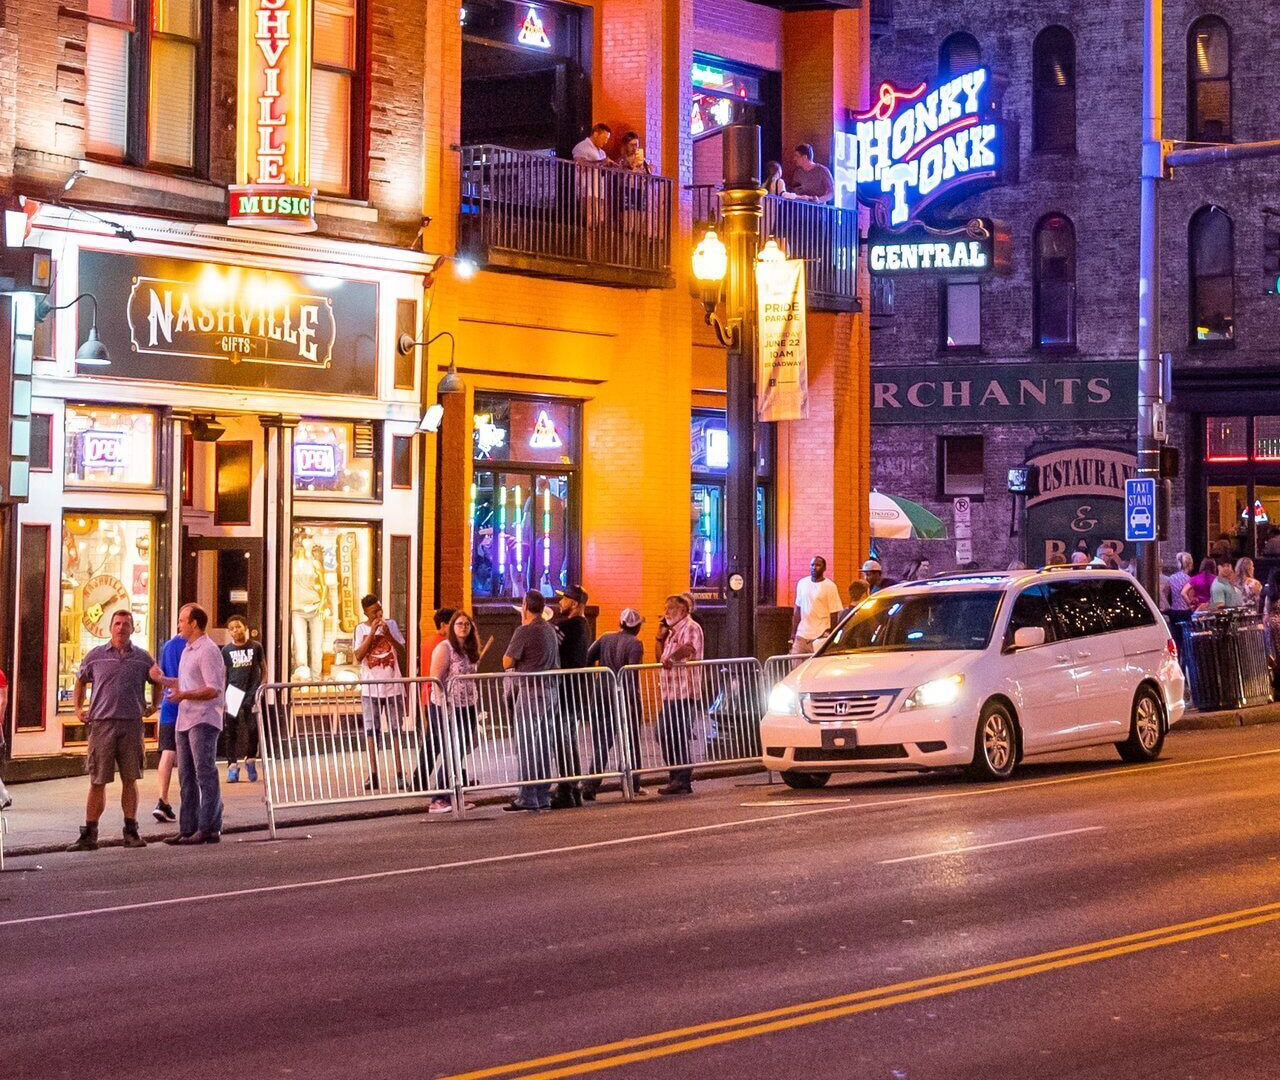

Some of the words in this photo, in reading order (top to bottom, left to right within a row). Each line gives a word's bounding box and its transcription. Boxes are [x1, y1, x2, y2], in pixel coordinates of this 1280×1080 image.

[856, 68, 986, 184] HONKY
[880, 124, 996, 226] TONK
[239, 195, 309, 215] MUSIC
[870, 241, 986, 271] CENTRAL
[764, 302, 800, 313] PRIDE
[765, 313, 800, 322] PARADE
[147, 287, 319, 361] NASHVILLE
[221, 336, 250, 353] GIFTS
[764, 340, 786, 348] JUNE
[789, 339, 800, 347] 22
[770, 350, 794, 359] 10AM
[765, 360, 801, 368] BROADWAY
[873, 377, 1112, 408] RCHANTS
[89, 439, 124, 462] OPEN
[299, 448, 332, 472] OPEN
[1039, 457, 1137, 493] ESTAURAN
[1132, 482, 1150, 494] TAXI
[1128, 495, 1152, 506] STAND
[1070, 505, 1098, 532] &
[341, 535, 354, 574] COLD
[82, 576, 128, 600] NASHVILLE
[343, 590, 357, 629] BEER
